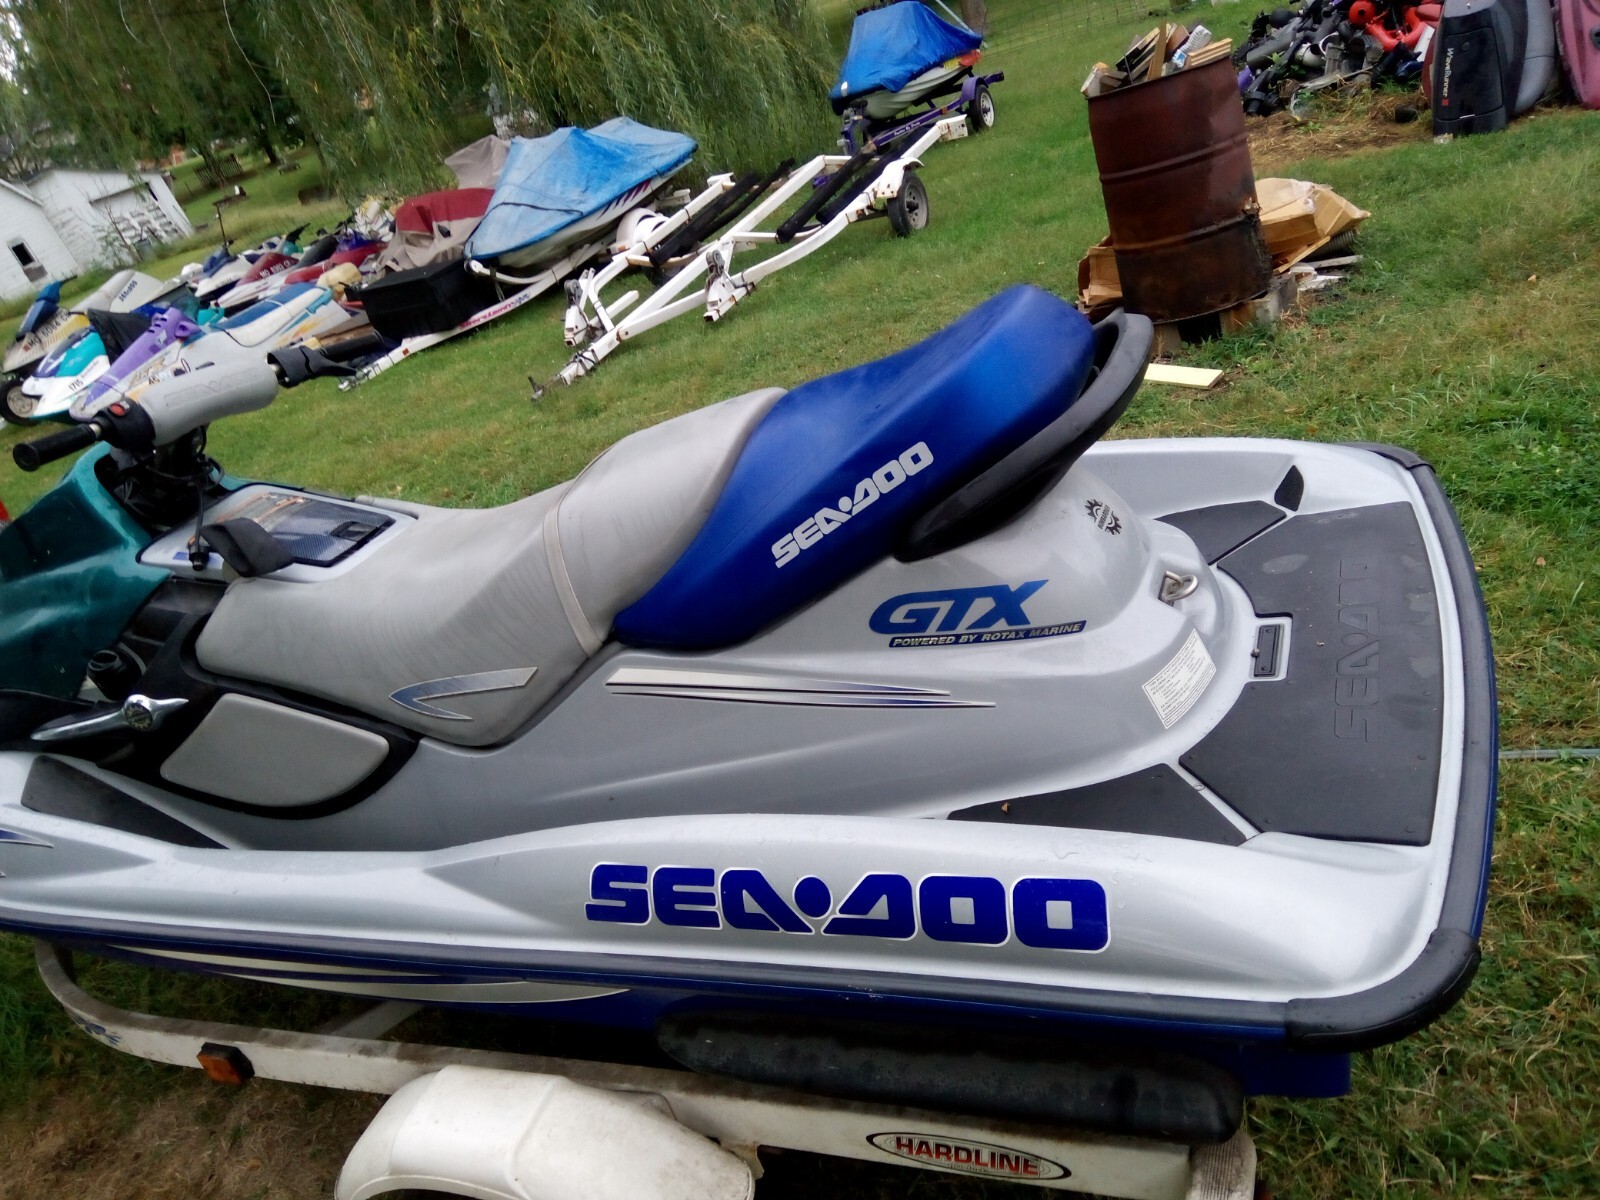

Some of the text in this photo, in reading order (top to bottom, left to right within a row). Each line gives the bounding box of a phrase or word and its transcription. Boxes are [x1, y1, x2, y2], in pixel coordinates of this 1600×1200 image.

[869, 579, 1049, 634] GTX
[892, 623, 1082, 647] POWERED BY ROTAX MARINE
[895, 1136, 1042, 1176] HARDLINE
